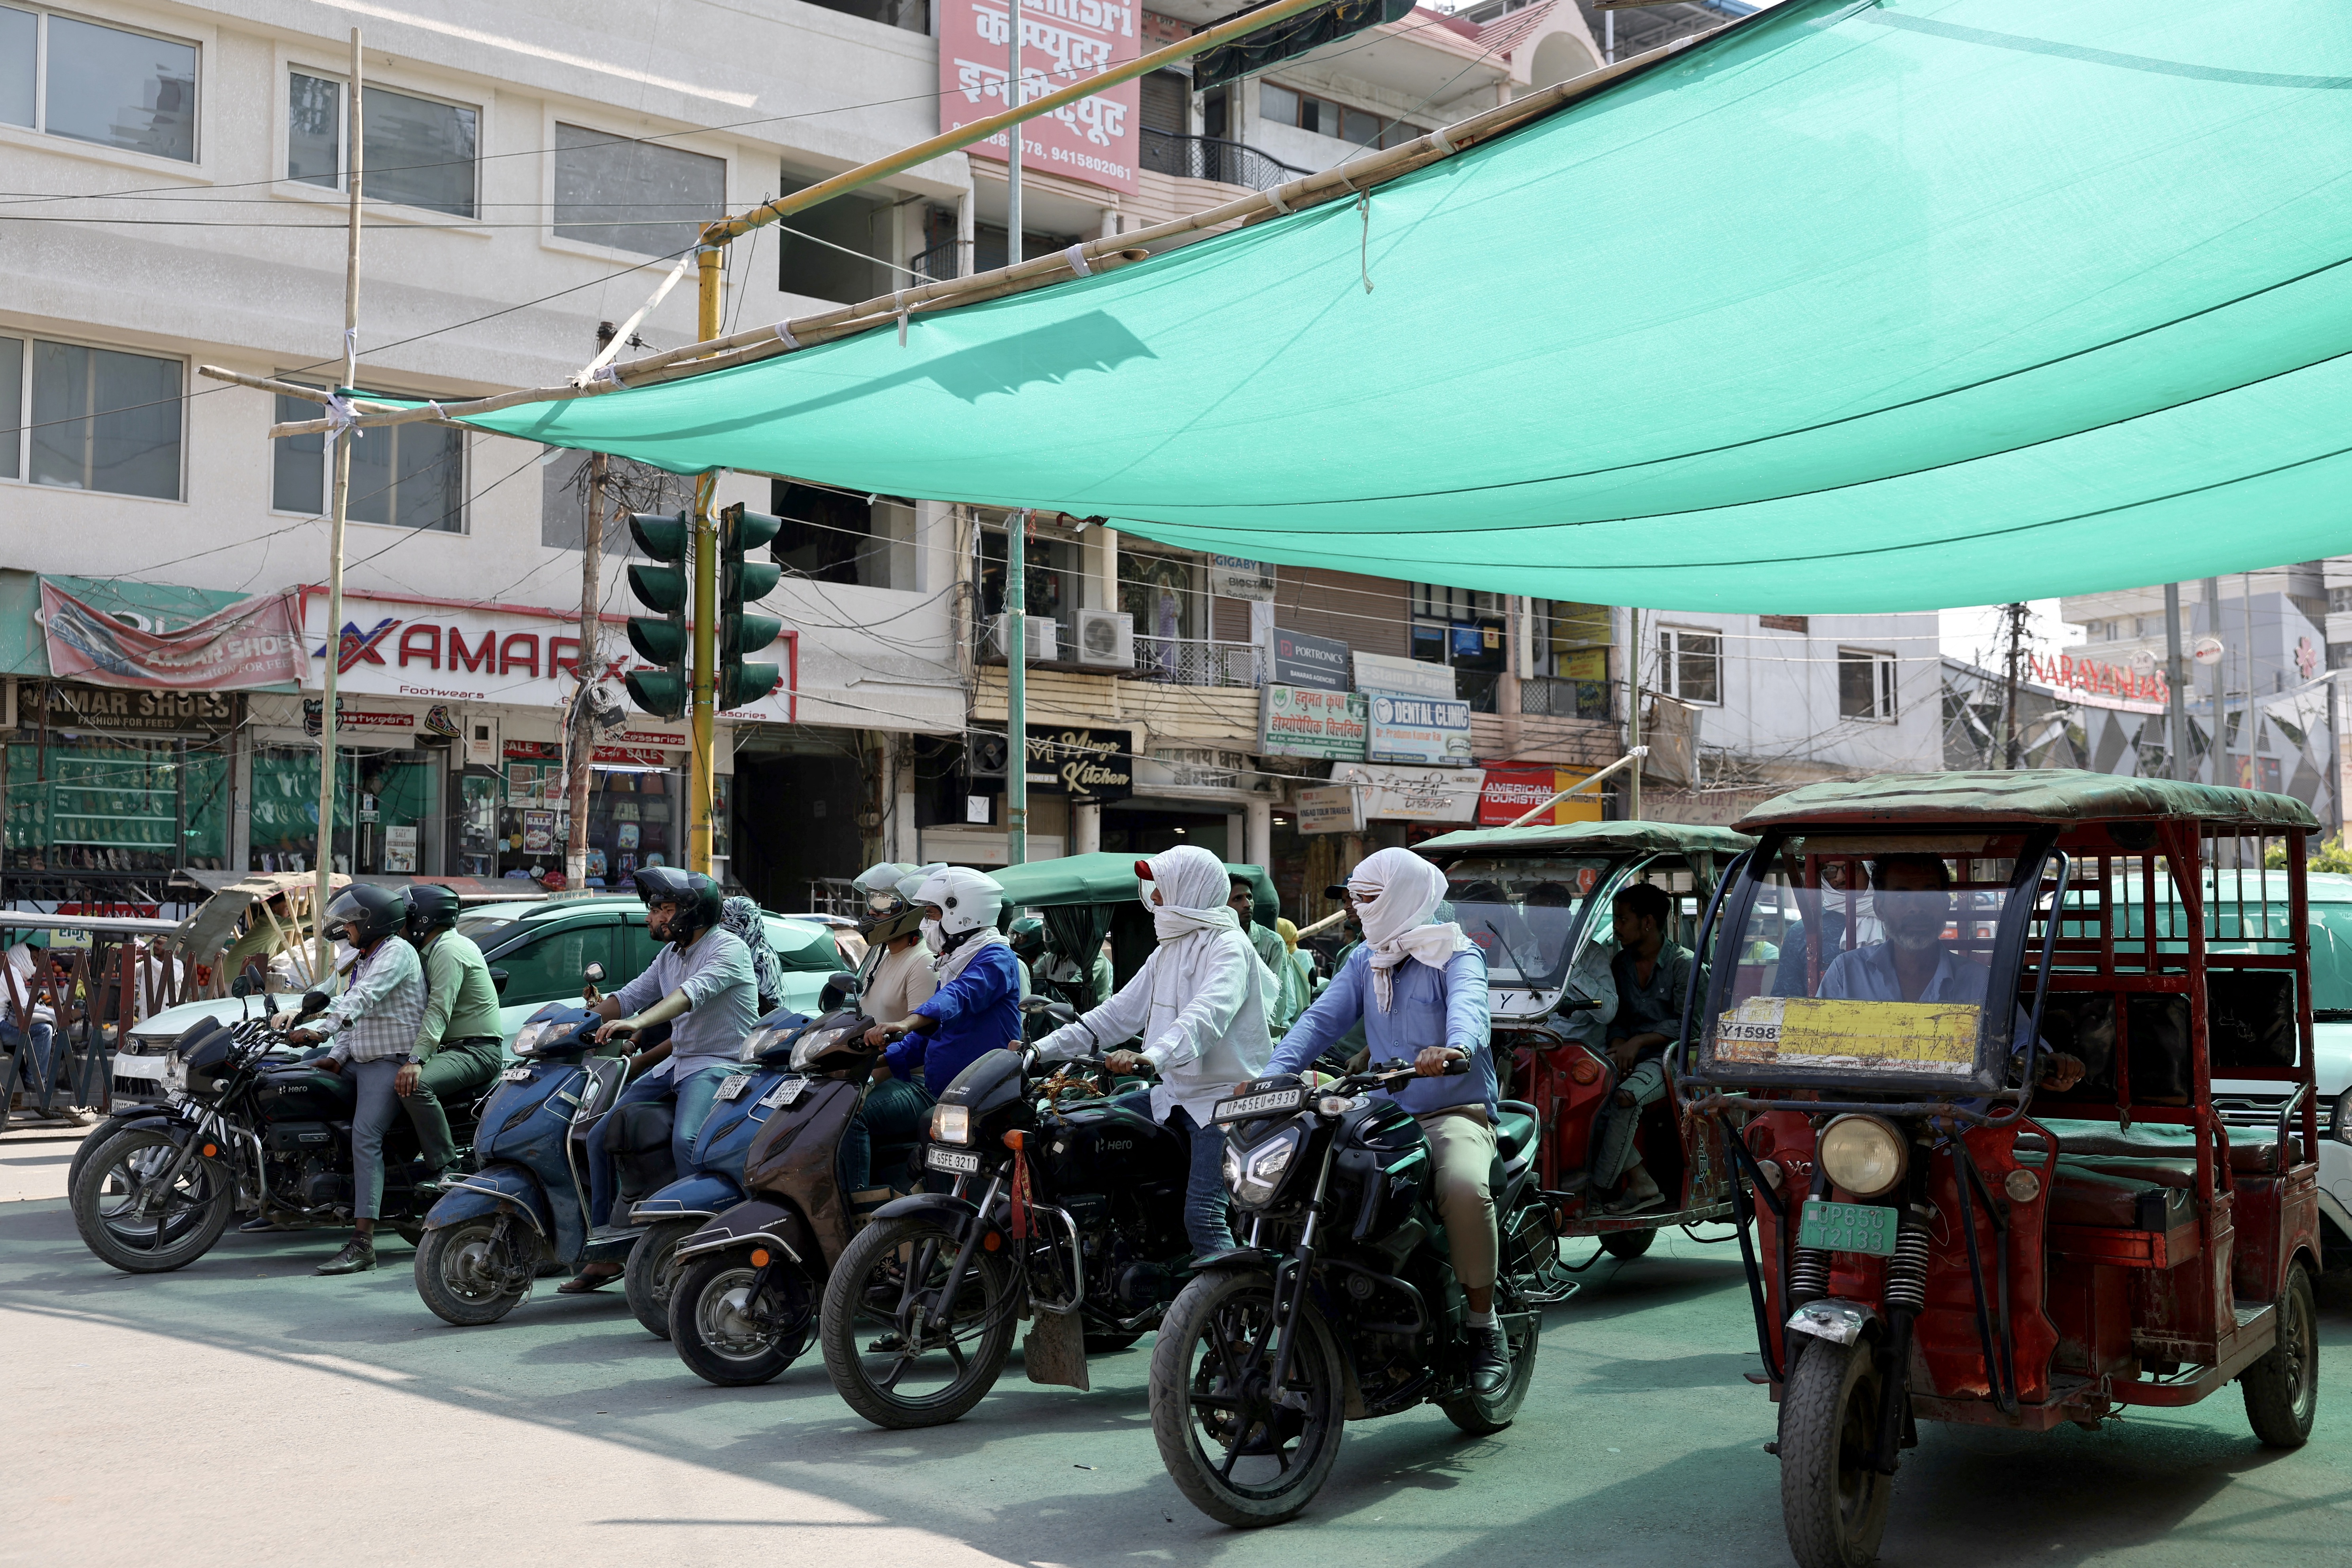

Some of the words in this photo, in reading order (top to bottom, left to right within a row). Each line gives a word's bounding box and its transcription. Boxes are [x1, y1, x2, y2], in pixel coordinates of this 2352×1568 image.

[1051, 147, 1131, 181] 9415802061
[1295, 645, 1343, 664] PORTRONICS
[238, 661, 266, 674] FOR
[1290, 670, 1313, 680] BANARAS
[1313, 674, 1336, 685] AGENCIES
[1358, 665, 1412, 686] E-Stamp
[1416, 672, 1453, 691] Paper
[399, 685, 484, 699] Footwears
[46, 690, 129, 715] AMAR
[138, 693, 230, 718] SHOES
[1295, 691, 1323, 711] हनुमत
[1326, 694, 1346, 713] कृपा
[342, 714, 411, 724] ootwears
[1394, 701, 1433, 725] DENTAL
[1435, 704, 1468, 727] CLINIC
[78, 716, 120, 726] FASHION
[123, 718, 142, 727] FOR
[145, 719, 175, 728] FEETS
[1326, 718, 1363, 738] क्लिनिक
[1413, 731, 1431, 741] Kumar
[1061, 730, 1121, 761] Mings
[626, 749, 658, 759] SALE
[1062, 760, 1130, 794] Kitchen
[1485, 782, 1552, 794] AMERICAN
[527, 817, 551, 826] SALE
[1500, 993, 1515, 1009] Y
[724, 1075, 745, 1086] UP65C
[781, 1080, 805, 1092] UP65C
[1254, 1081, 1273, 1091] TVS
[1226, 1101, 1238, 1114] UP
[1242, 1095, 1267, 1111] 65EU
[1270, 1091, 1296, 1105] 9938
[1107, 1140, 1133, 1150] Hero
[937, 1153, 953, 1166] 65FE
[955, 1156, 976, 1169] 3211
[1819, 1227, 1883, 1251] T2133
